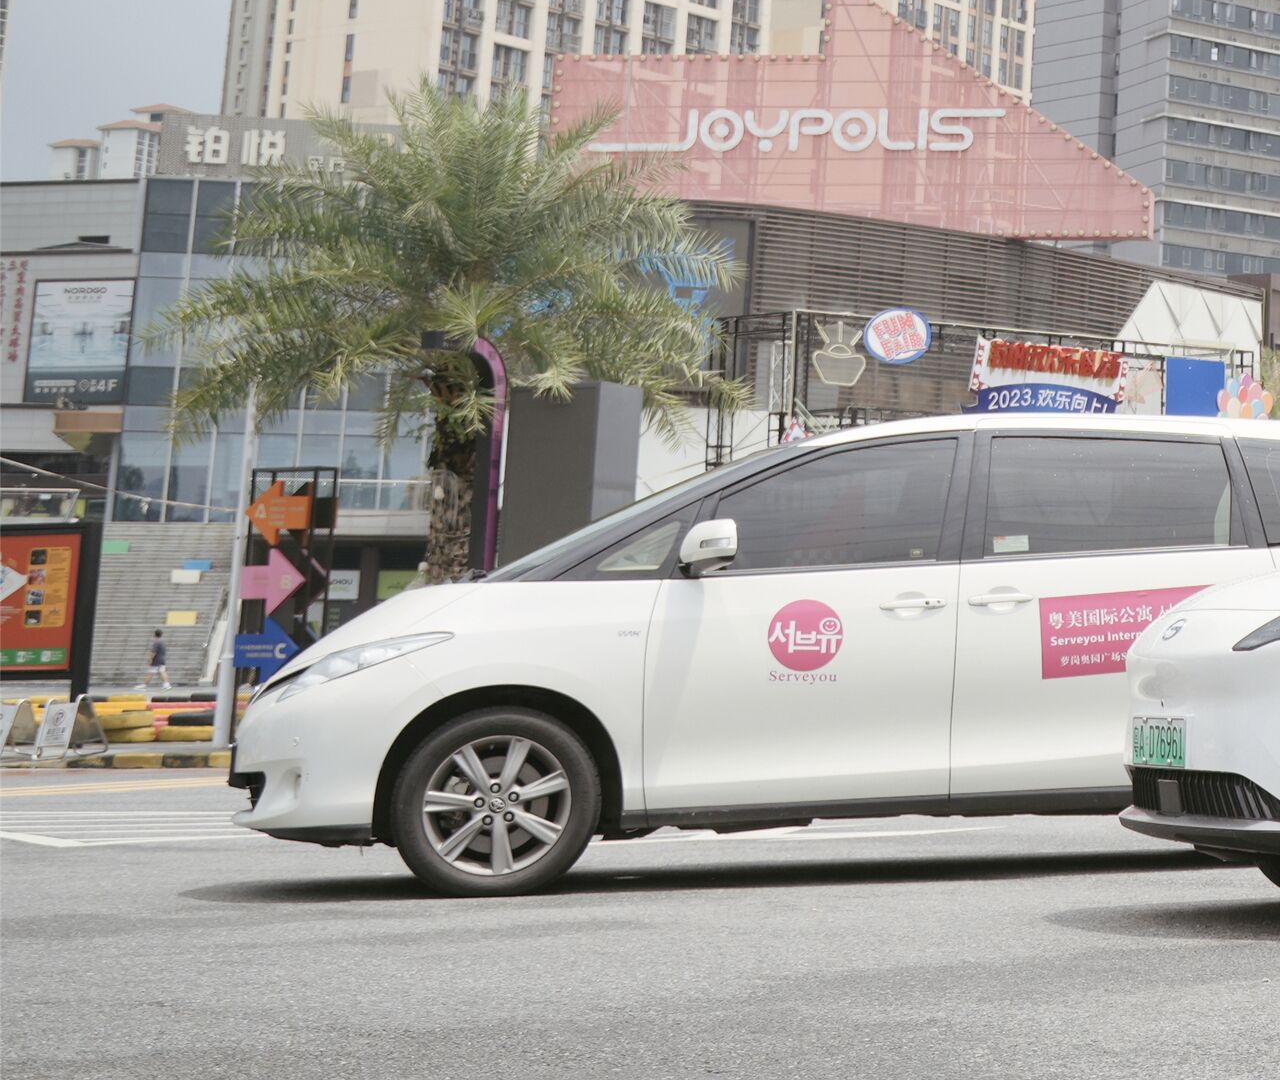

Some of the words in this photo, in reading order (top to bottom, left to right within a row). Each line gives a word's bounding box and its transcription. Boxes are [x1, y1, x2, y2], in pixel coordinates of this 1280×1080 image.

[588, 108, 1007, 152] JOYPOLIS
[255, 503, 267, 519] A
[1048, 605, 1152, 630] 粤美国际公寓
[768, 617, 844, 654] 서브유
[1050, 634, 1105, 648] Serveyou
[274, 642, 287, 660] C
[769, 670, 837, 686] Serveyou
